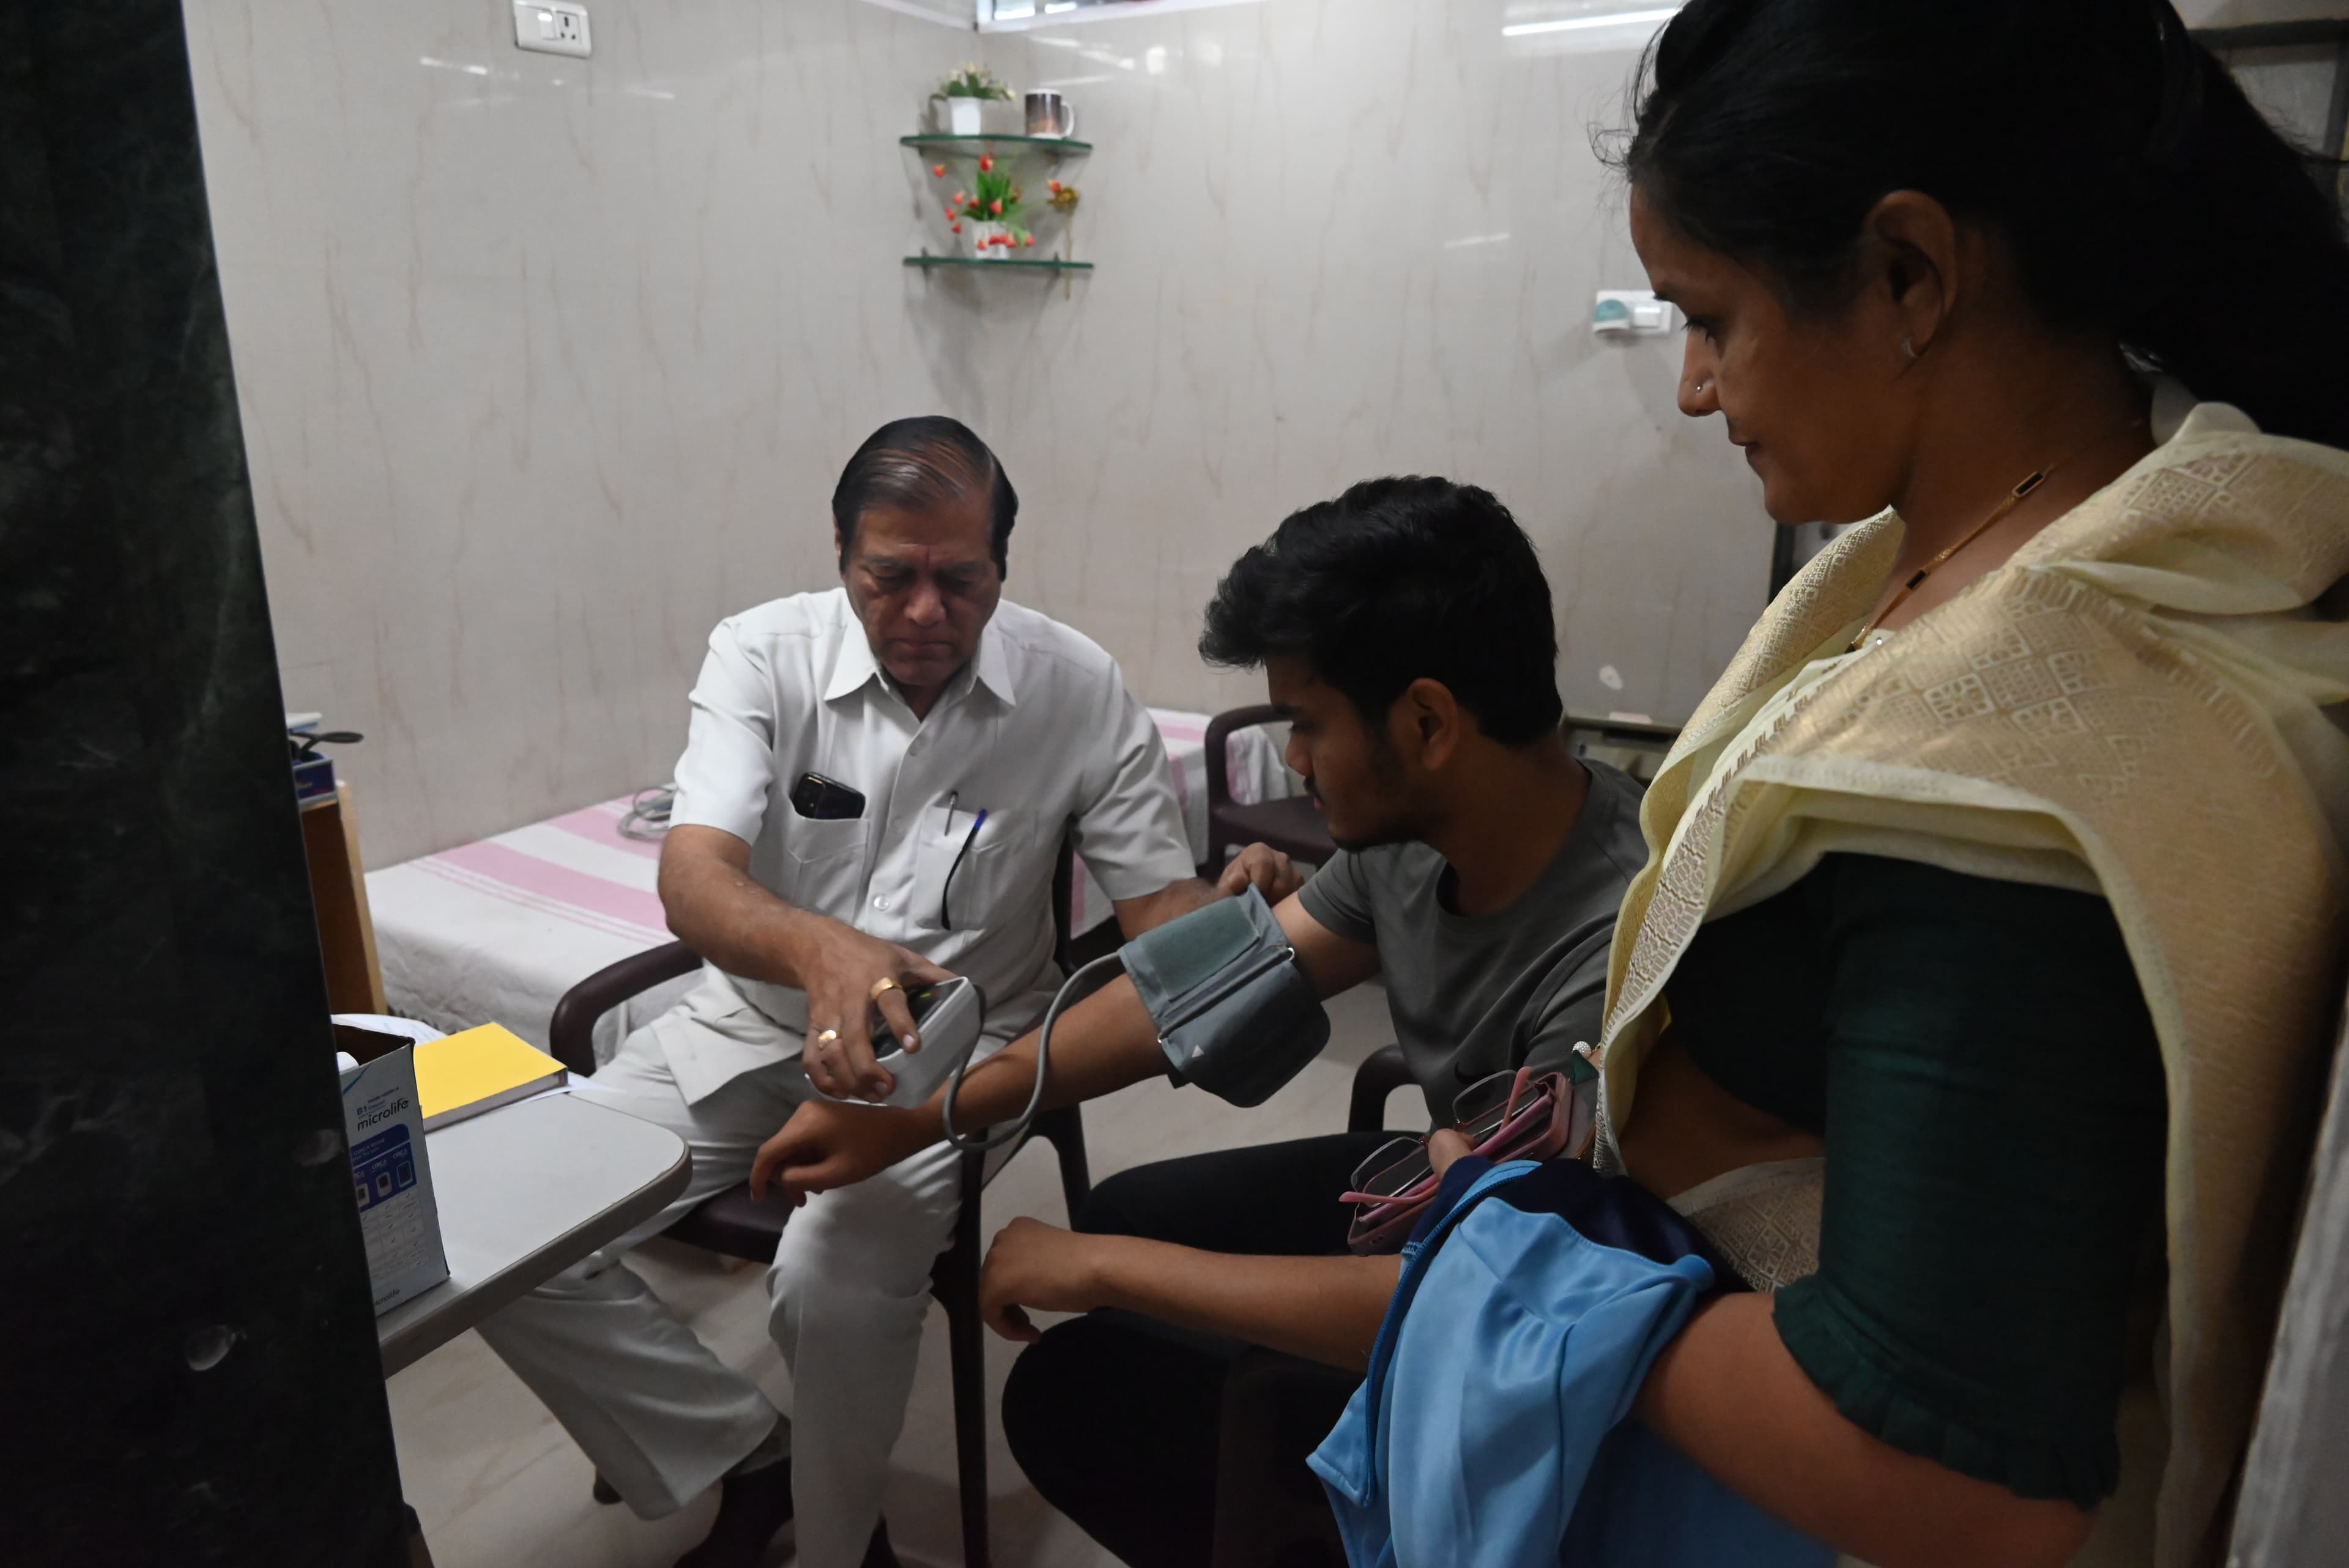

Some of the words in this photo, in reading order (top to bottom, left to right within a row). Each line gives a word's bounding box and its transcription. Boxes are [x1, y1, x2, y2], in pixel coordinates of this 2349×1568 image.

[357, 1105, 367, 1115] B1
[358, 1098, 409, 1131] microlife
[373, 1288, 400, 1305] icrolife
